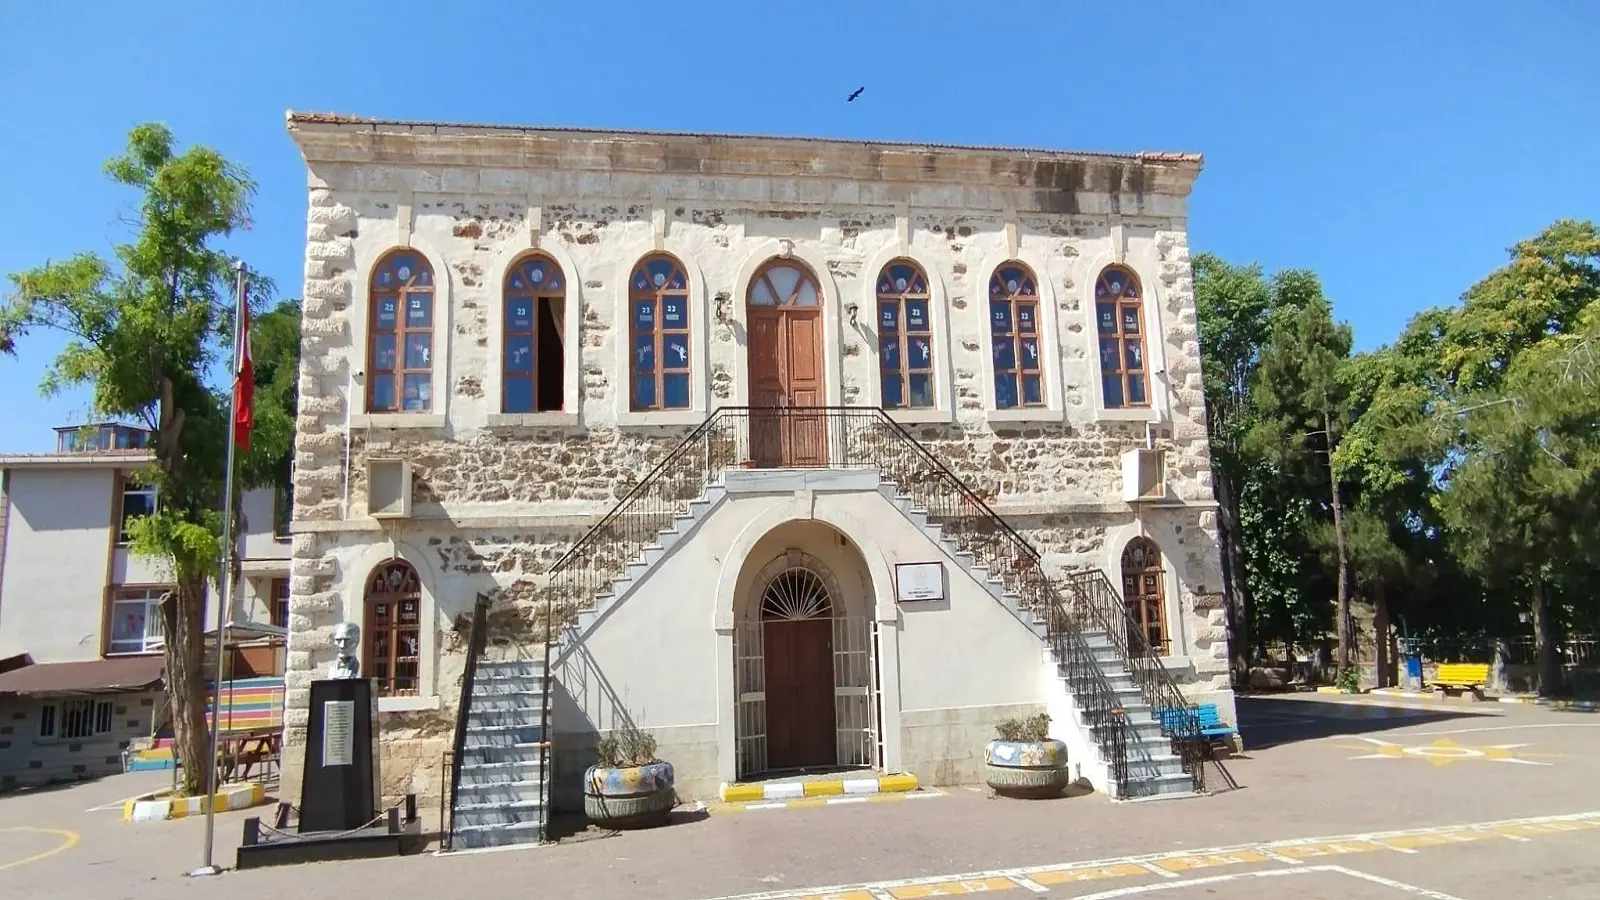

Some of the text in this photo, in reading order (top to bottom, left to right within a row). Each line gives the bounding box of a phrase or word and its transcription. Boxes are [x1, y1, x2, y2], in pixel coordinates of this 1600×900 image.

[385, 303, 393, 311] 23
[412, 300, 420, 308] 23
[517, 308, 526, 316] 23
[912, 308, 920, 316] 23
[405, 603, 413, 611] 23
